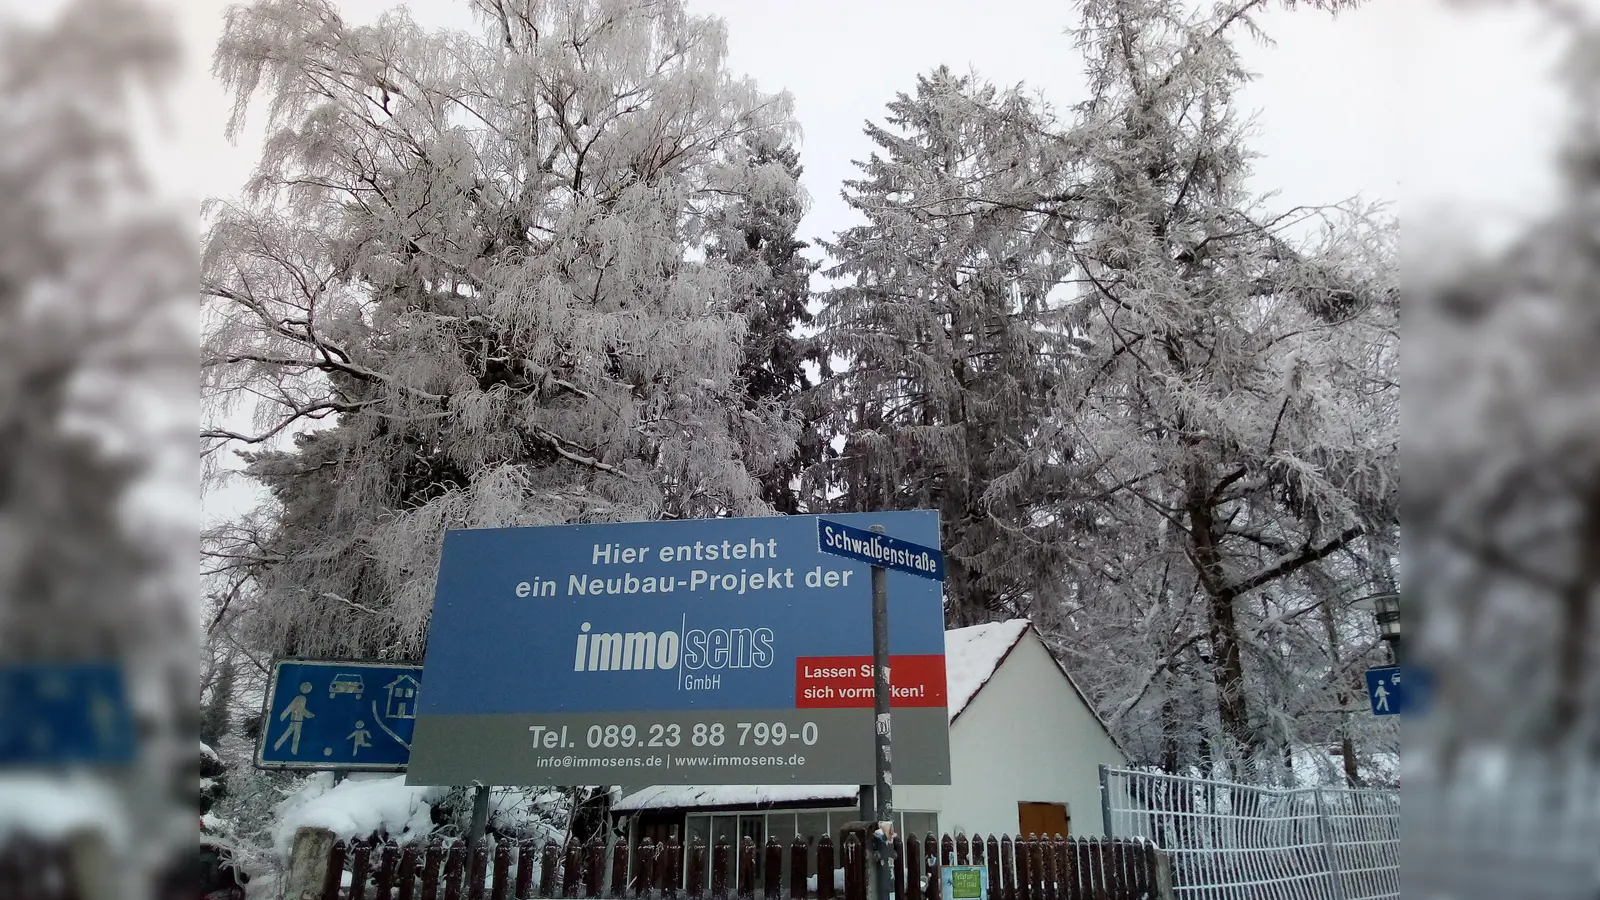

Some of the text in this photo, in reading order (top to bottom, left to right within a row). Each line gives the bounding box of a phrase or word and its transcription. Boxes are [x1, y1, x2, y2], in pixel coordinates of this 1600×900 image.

[592, 538, 777, 564] Hier entsteht
[824, 526, 936, 573] Schwalbenstraße
[515, 566, 853, 598] ein Neubau-Projekt der
[804, 664, 875, 678] Lassen Si
[685, 674, 721, 690] GmbH
[804, 684, 925, 698] sich vormken!
[528, 721, 819, 748] Tel. 089.23 88 799-0
[536, 754, 663, 768] info@immosens.de
[675, 754, 806, 767] www.immosens.de
